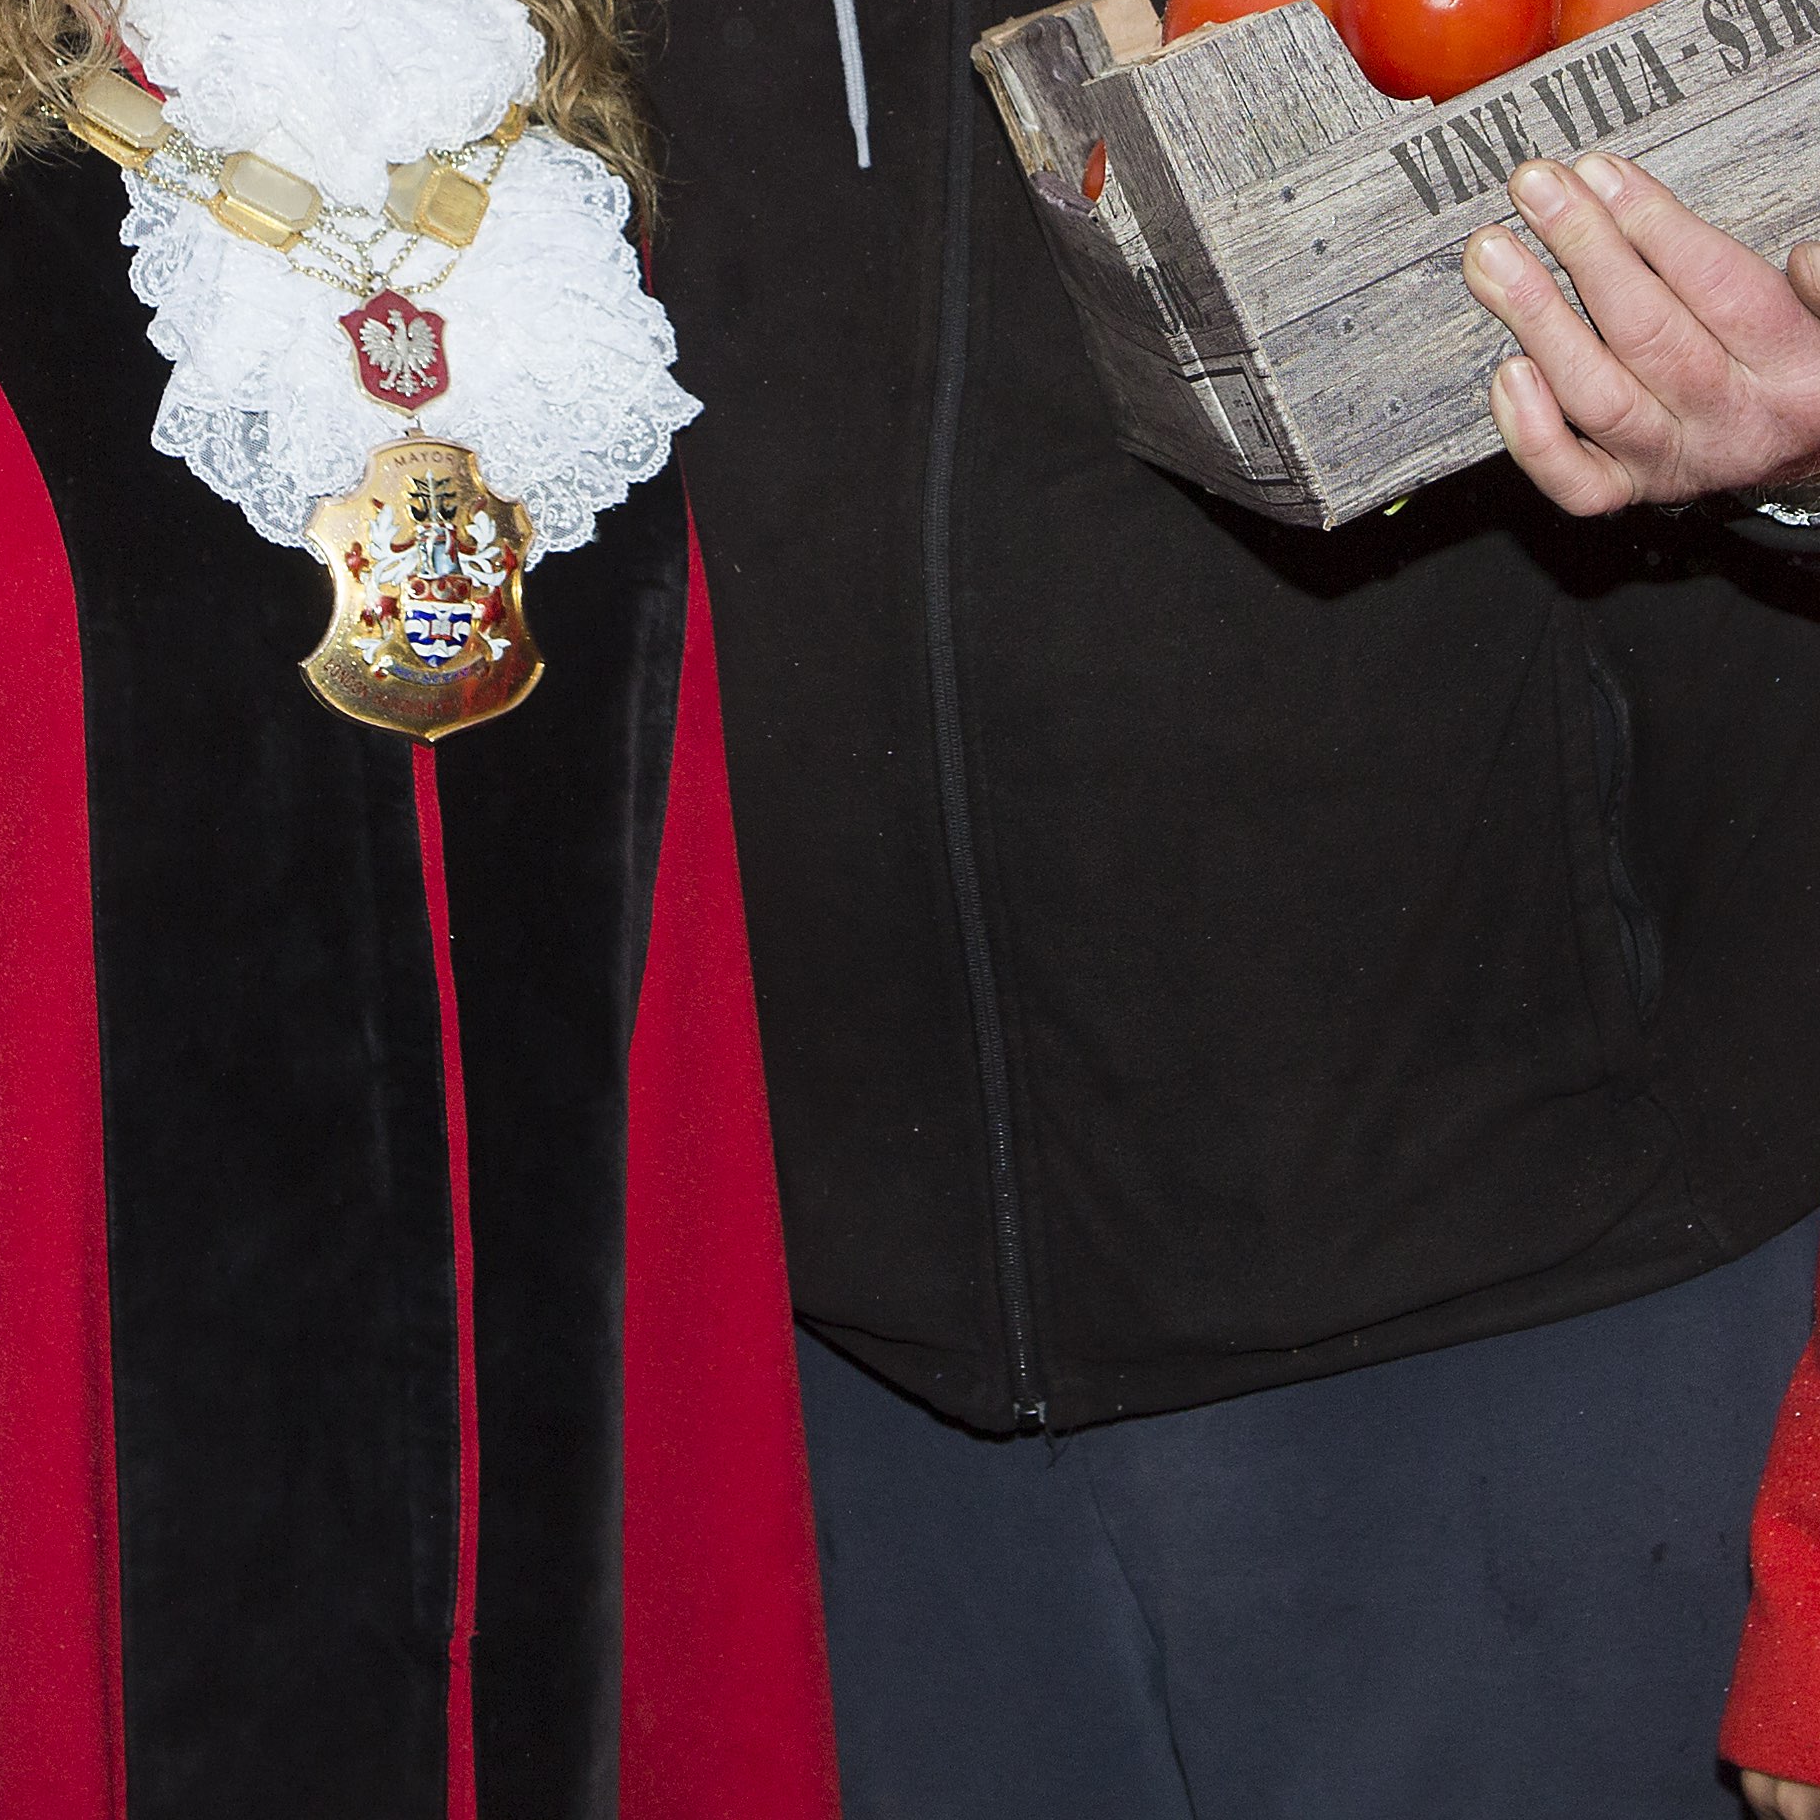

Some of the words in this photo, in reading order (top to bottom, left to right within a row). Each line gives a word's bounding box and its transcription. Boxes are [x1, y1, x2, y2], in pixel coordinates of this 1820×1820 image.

[1389, 91, 1543, 216] VINE
[1530, 30, 1686, 150] VITA
[392, 450, 455, 469] MAYOR
[323, 658, 369, 698] LONDON
